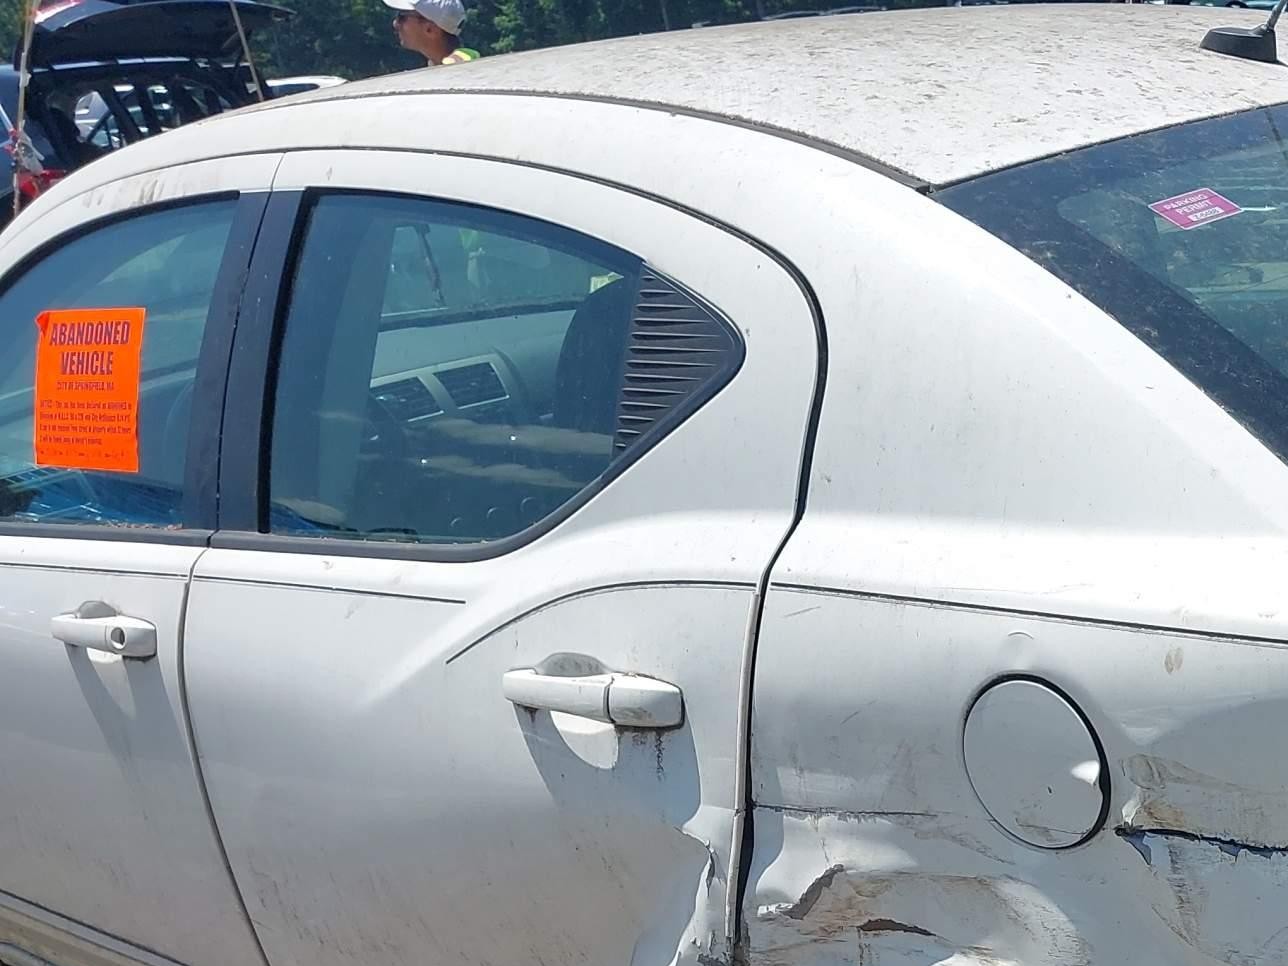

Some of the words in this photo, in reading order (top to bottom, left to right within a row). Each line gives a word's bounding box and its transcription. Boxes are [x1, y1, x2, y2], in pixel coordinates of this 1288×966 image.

[1163, 194, 1208, 210] PARKING
[1175, 200, 1214, 215] PERMIT
[49, 320, 130, 346] ABANDONED
[61, 351, 114, 376] VEHICLE
